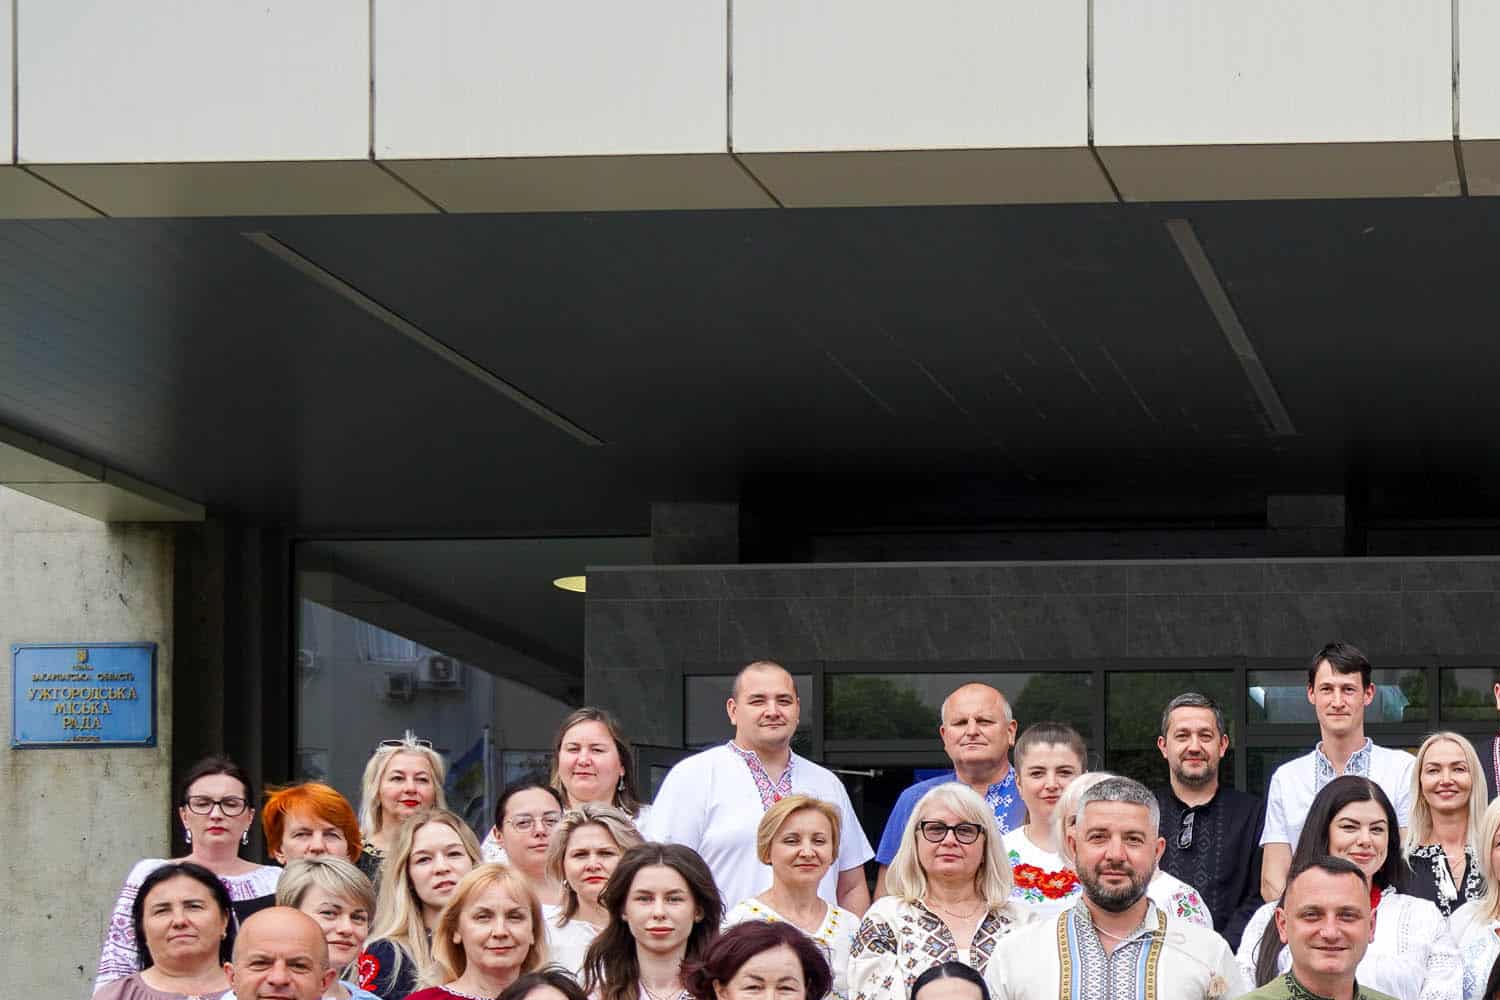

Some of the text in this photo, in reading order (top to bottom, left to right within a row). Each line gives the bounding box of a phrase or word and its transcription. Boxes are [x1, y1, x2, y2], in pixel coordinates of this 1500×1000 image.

[28, 687, 138, 701] УЖГОРОДСЬКА
[55, 702, 111, 715] МІСЬКА
[63, 716, 101, 731] РАДА
